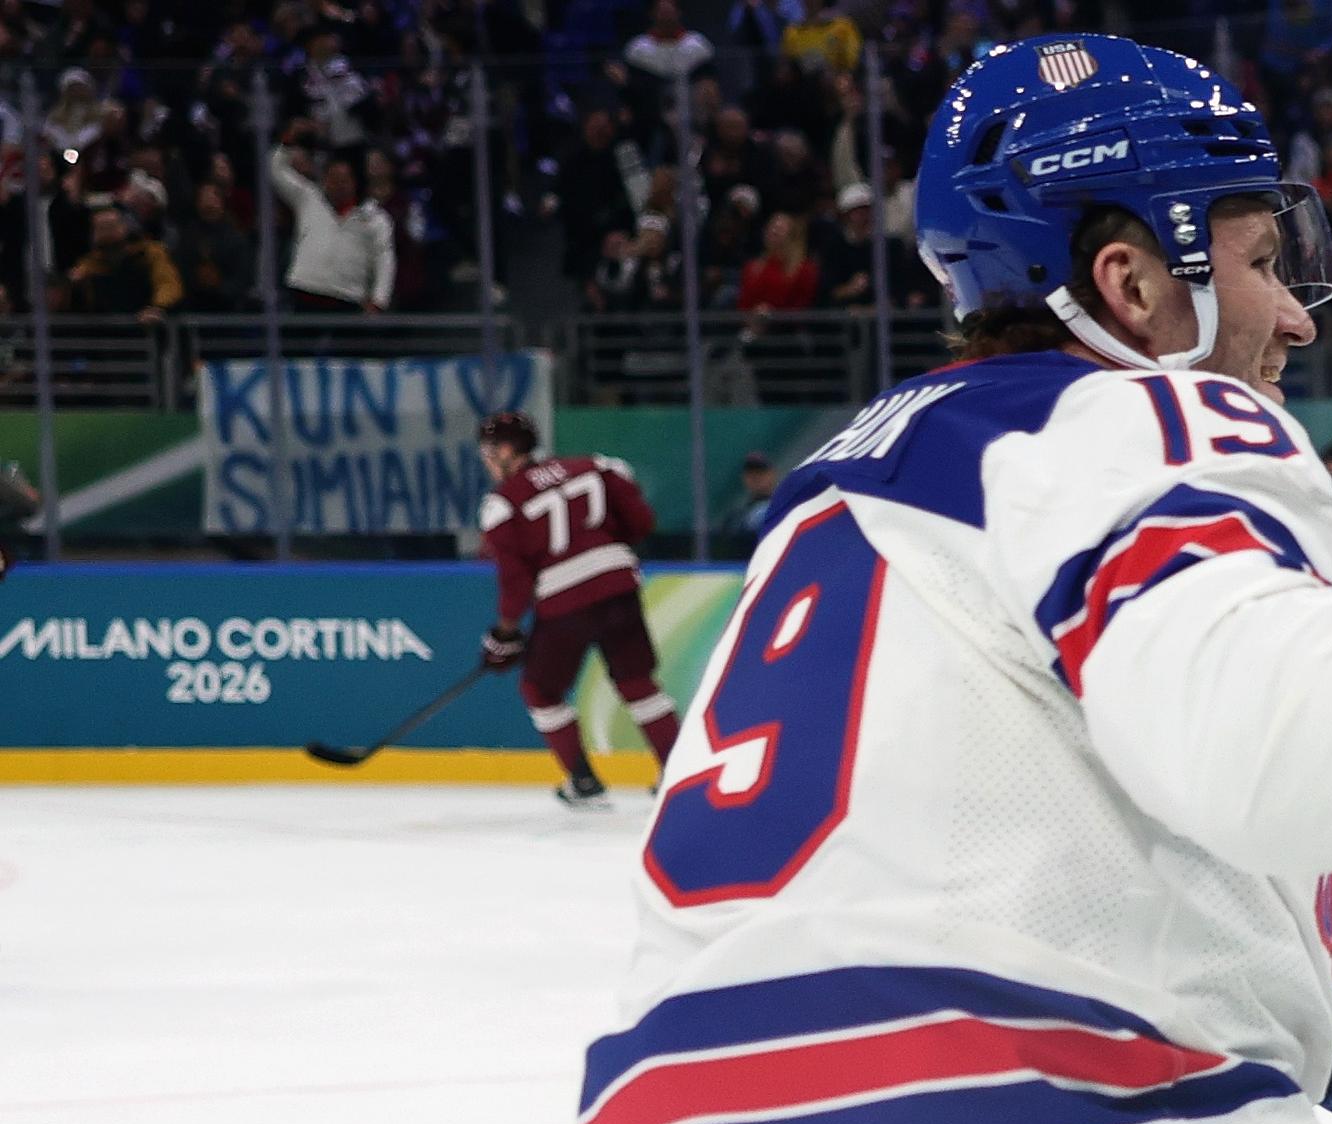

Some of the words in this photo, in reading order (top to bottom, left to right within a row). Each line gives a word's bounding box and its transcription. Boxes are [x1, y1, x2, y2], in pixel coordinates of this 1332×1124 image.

[1043, 43, 1077, 55] USA
[1030, 139, 1130, 177] CCM
[1171, 264, 1211, 277] CCM
[1129, 374, 1302, 466] 19
[522, 468, 608, 556] 77
[0, 616, 211, 661] MILANO
[216, 616, 433, 662] CORTINA
[165, 661, 272, 704] 2026
[643, 498, 889, 909] 9
